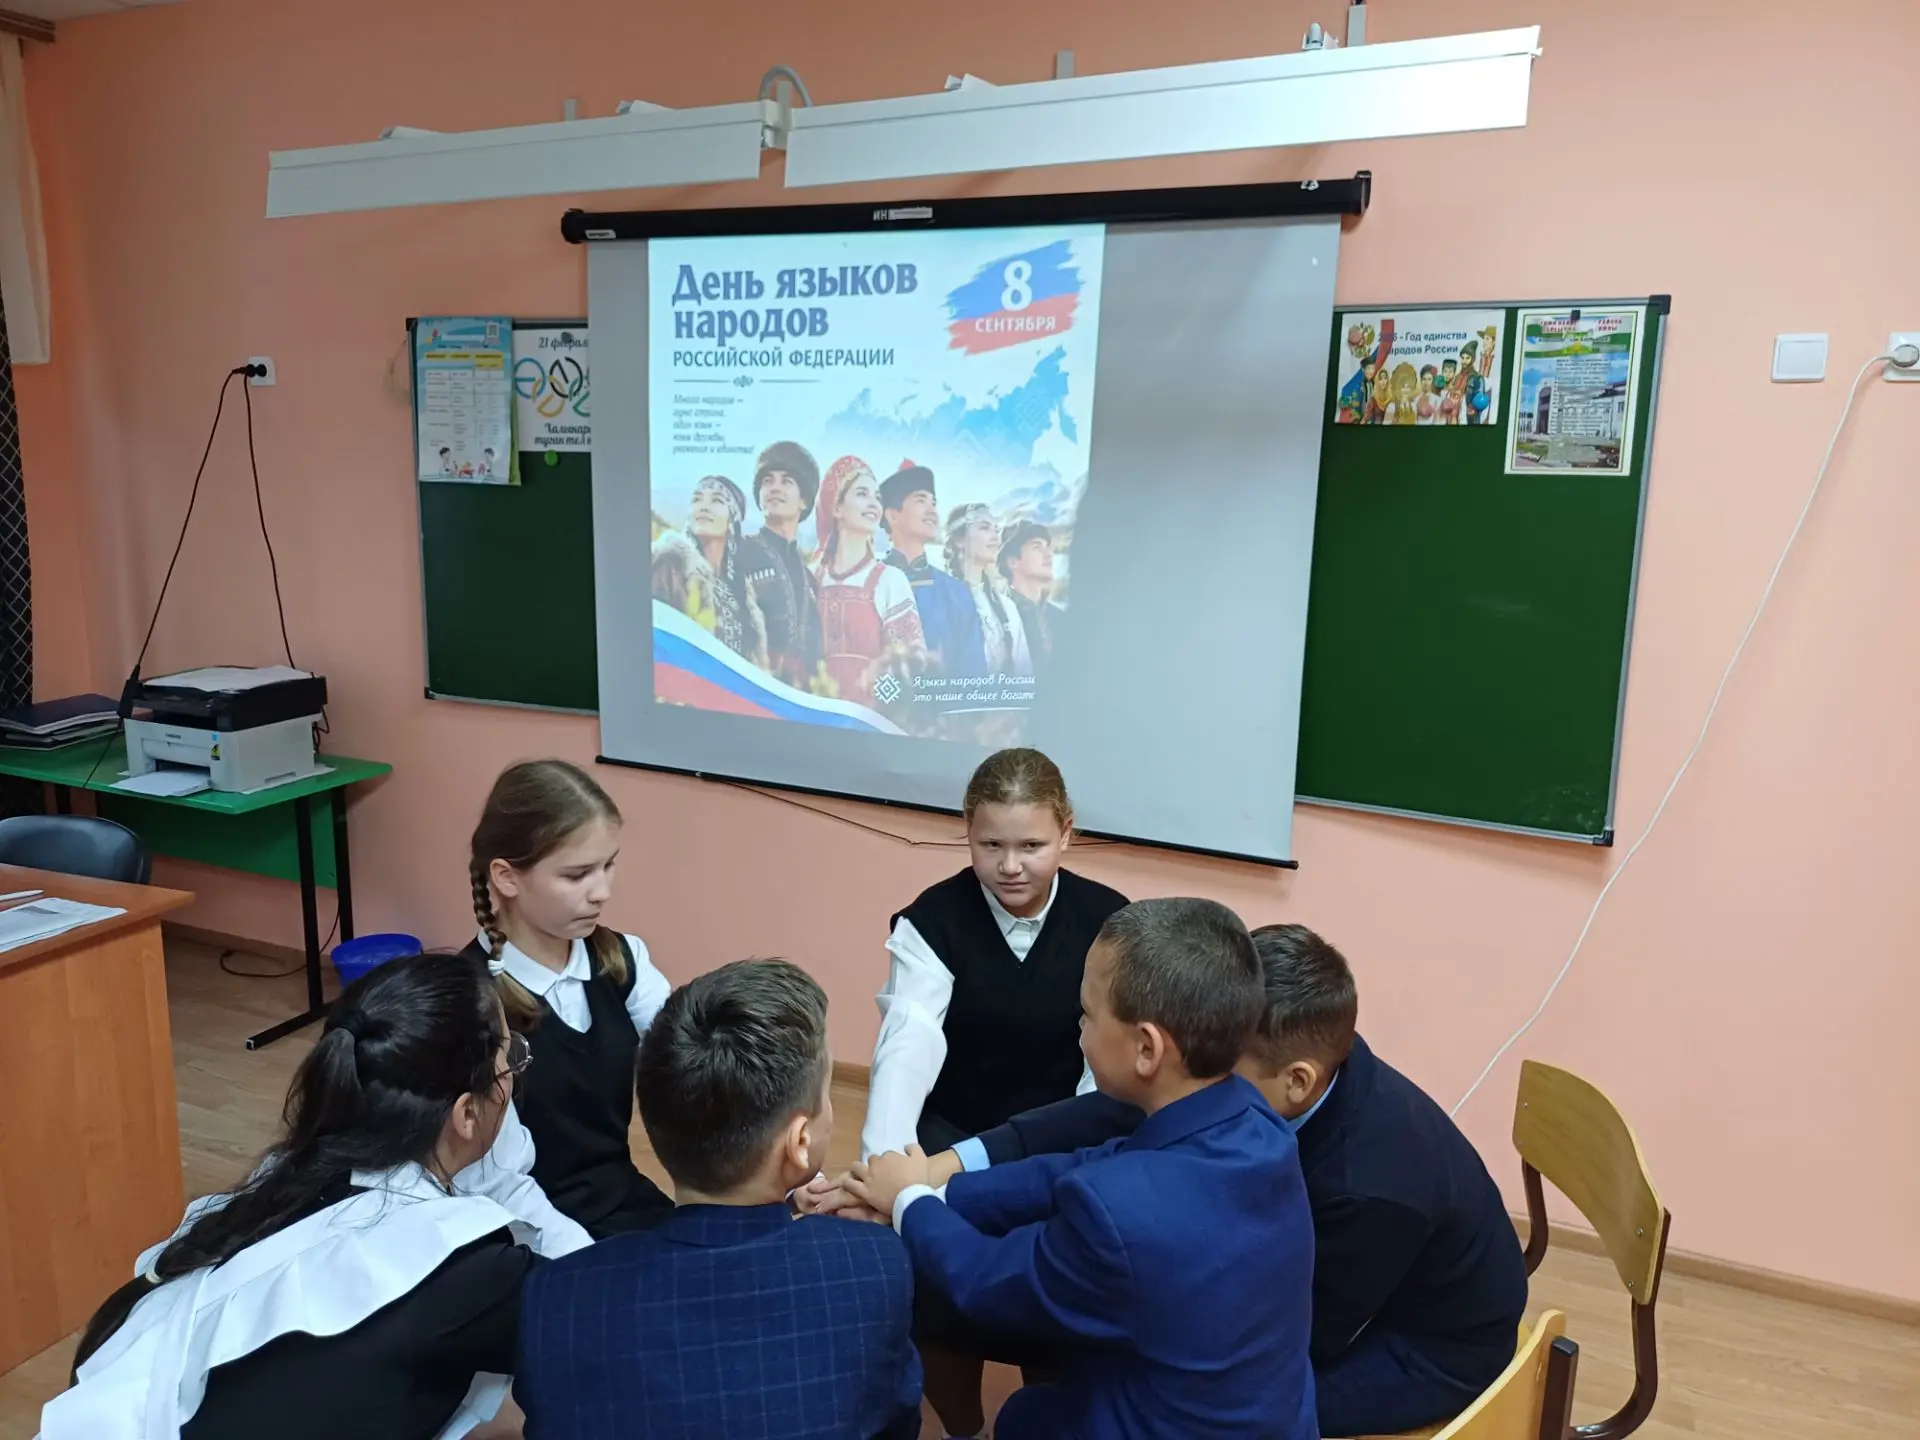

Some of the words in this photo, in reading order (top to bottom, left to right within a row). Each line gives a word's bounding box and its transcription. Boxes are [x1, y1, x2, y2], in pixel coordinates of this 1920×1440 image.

[672, 264, 764, 307] День
[775, 263, 918, 299] языков
[1001, 260, 1032, 311] 8
[674, 307, 829, 347] народов
[975, 315, 1056, 333] СЕНТЯБРЯ
[538, 337, 549, 348] 21
[1405, 332, 1422, 342] Год
[1423, 332, 1467, 341] единства
[673, 347, 783, 367] РОССИЙСКОЙ
[789, 349, 895, 368] ФЕДЕРАЦИИ
[1424, 345, 1458, 354] России
[913, 675, 946, 689] Языки
[950, 674, 994, 688] народов
[998, 673, 1036, 685] России
[913, 693, 932, 702] это
[935, 692, 963, 701] наше
[966, 690, 998, 702] общее
